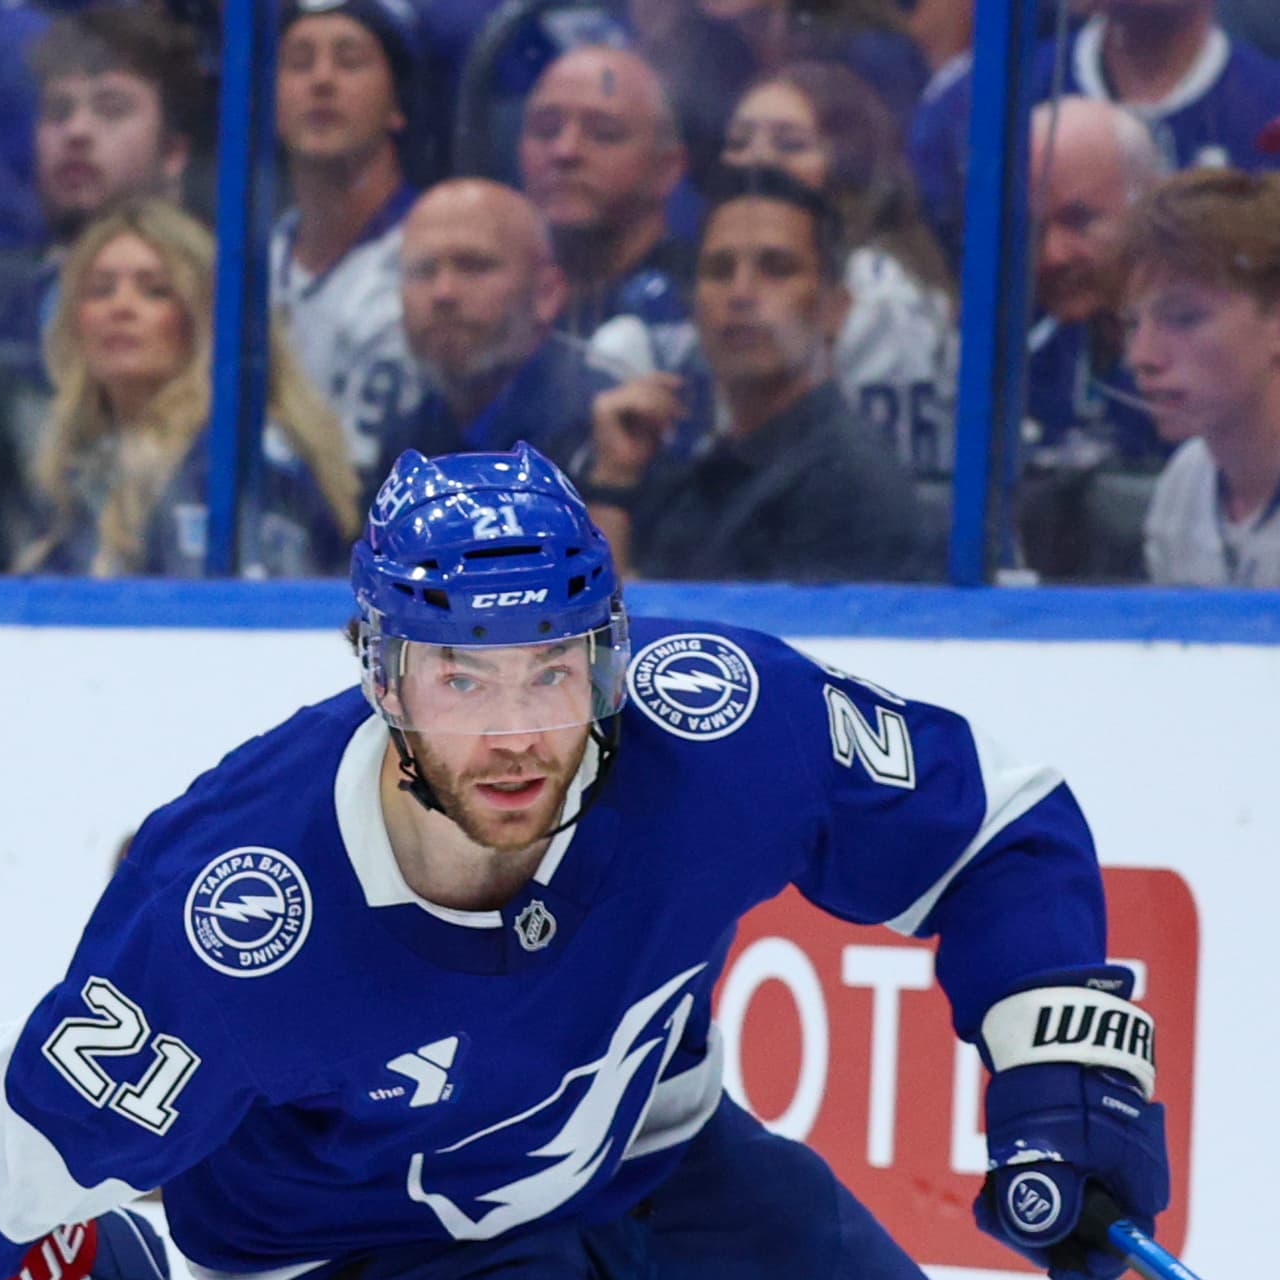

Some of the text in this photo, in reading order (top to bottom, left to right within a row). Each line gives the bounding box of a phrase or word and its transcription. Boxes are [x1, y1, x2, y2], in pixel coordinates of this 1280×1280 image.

[470, 506, 524, 541] 21
[471, 589, 549, 609] CCM
[637, 639, 702, 697] LIGHTNING
[648, 699, 682, 725] BAY
[687, 700, 744, 731] TAMPA
[822, 666, 916, 790] 2
[199, 855, 302, 967] TAMPA BAY LIGHTNING
[41, 975, 202, 1137] 21
[1032, 1005, 1156, 1067] WAR
